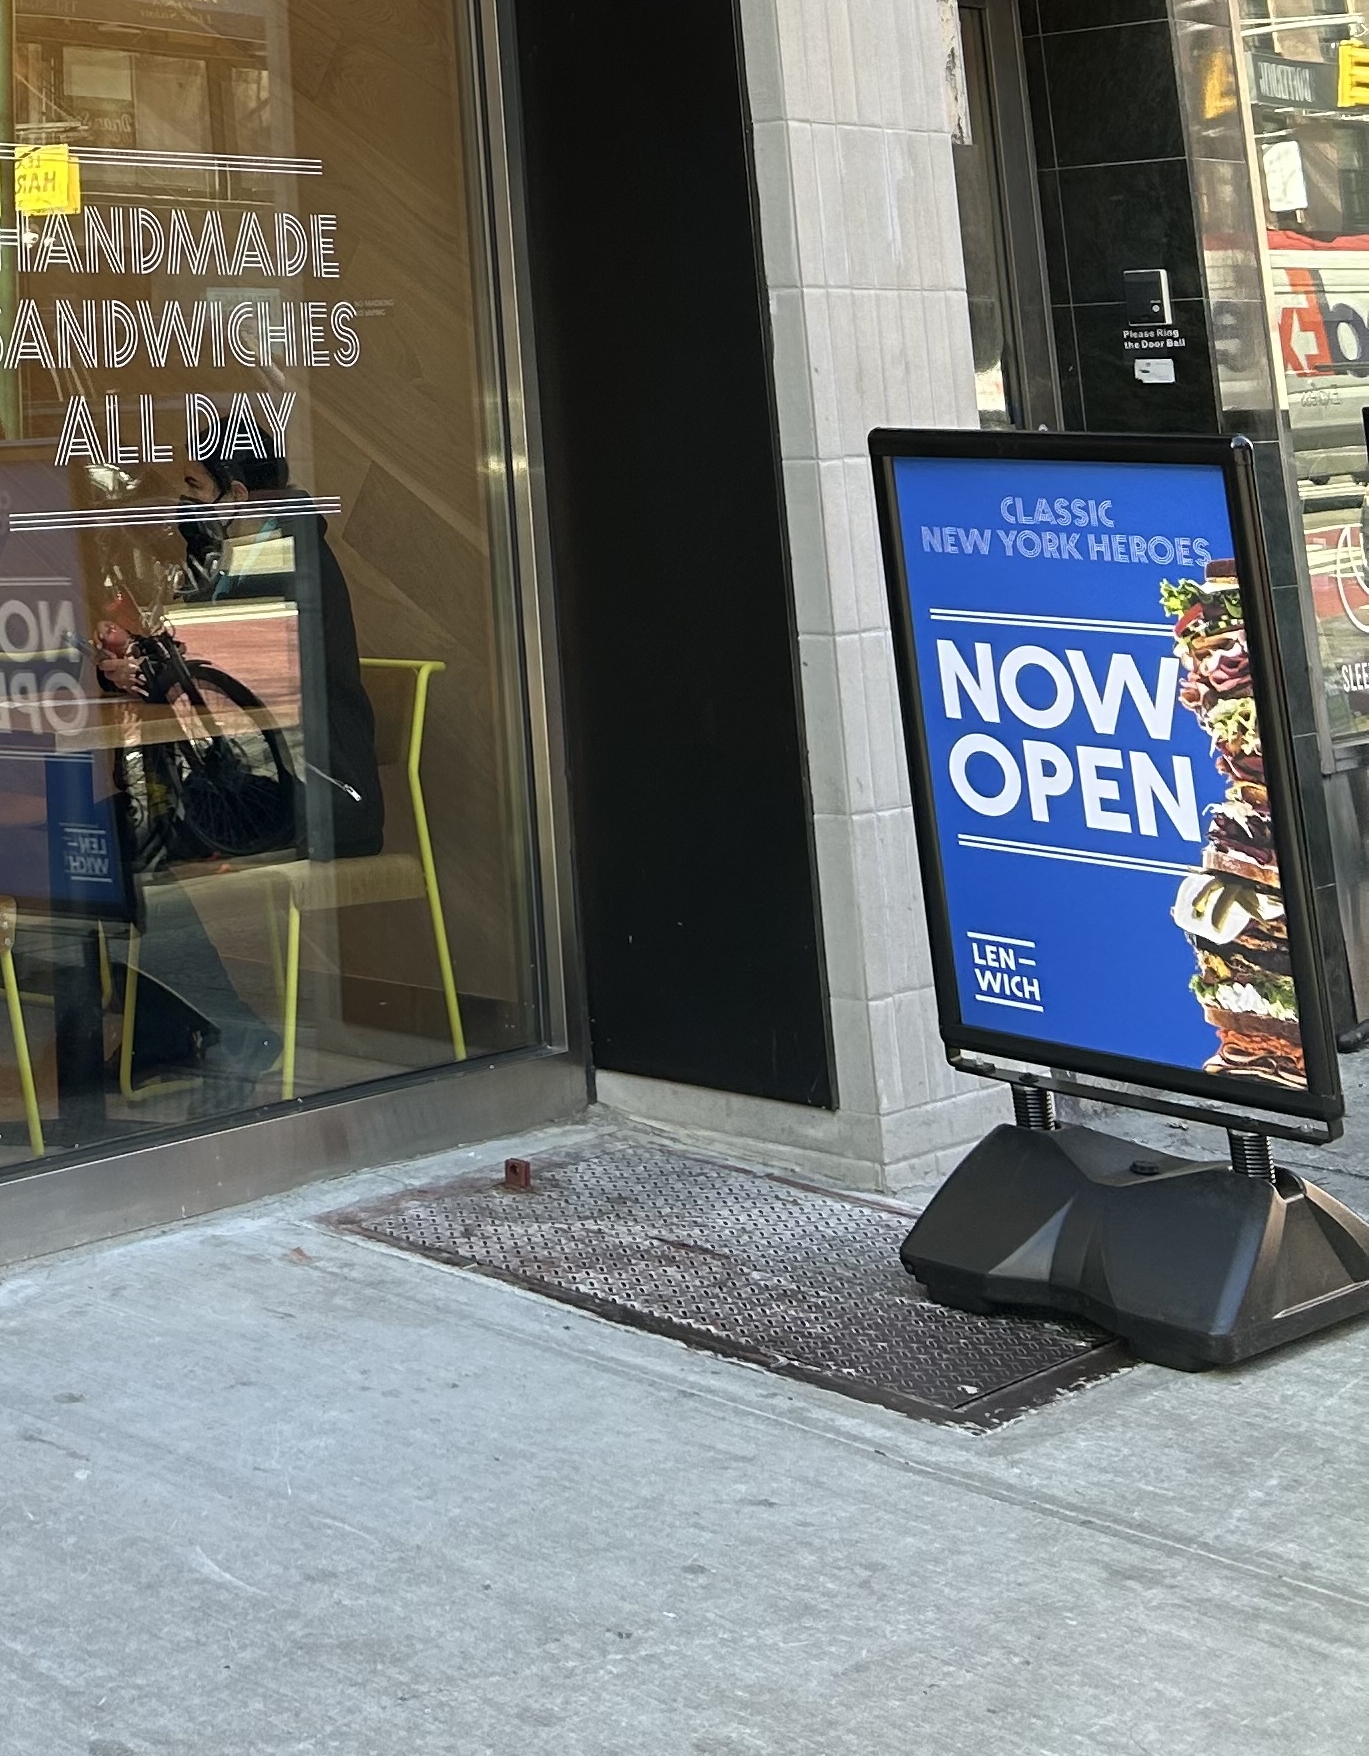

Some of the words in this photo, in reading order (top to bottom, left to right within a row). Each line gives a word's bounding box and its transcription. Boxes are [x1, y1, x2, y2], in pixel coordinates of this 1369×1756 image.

[1123, 329, 1155, 339] Please
[1156, 328, 1180, 338] Ring
[1124, 341, 1140, 350] the
[1141, 339, 1165, 349] Door
[55, 393, 174, 467] ALL
[187, 392, 297, 462] DAY
[1000, 495, 1115, 528] CLASSIC
[921, 526, 991, 556] NEW
[997, 529, 1084, 561] YORK
[1087, 533, 1213, 568] HEROES
[936, 638, 1181, 742] NOW
[1342, 662, 1369, 693] SLEE
[948, 732, 1202, 842] OPEN
[974, 968, 1041, 1002] WICH
